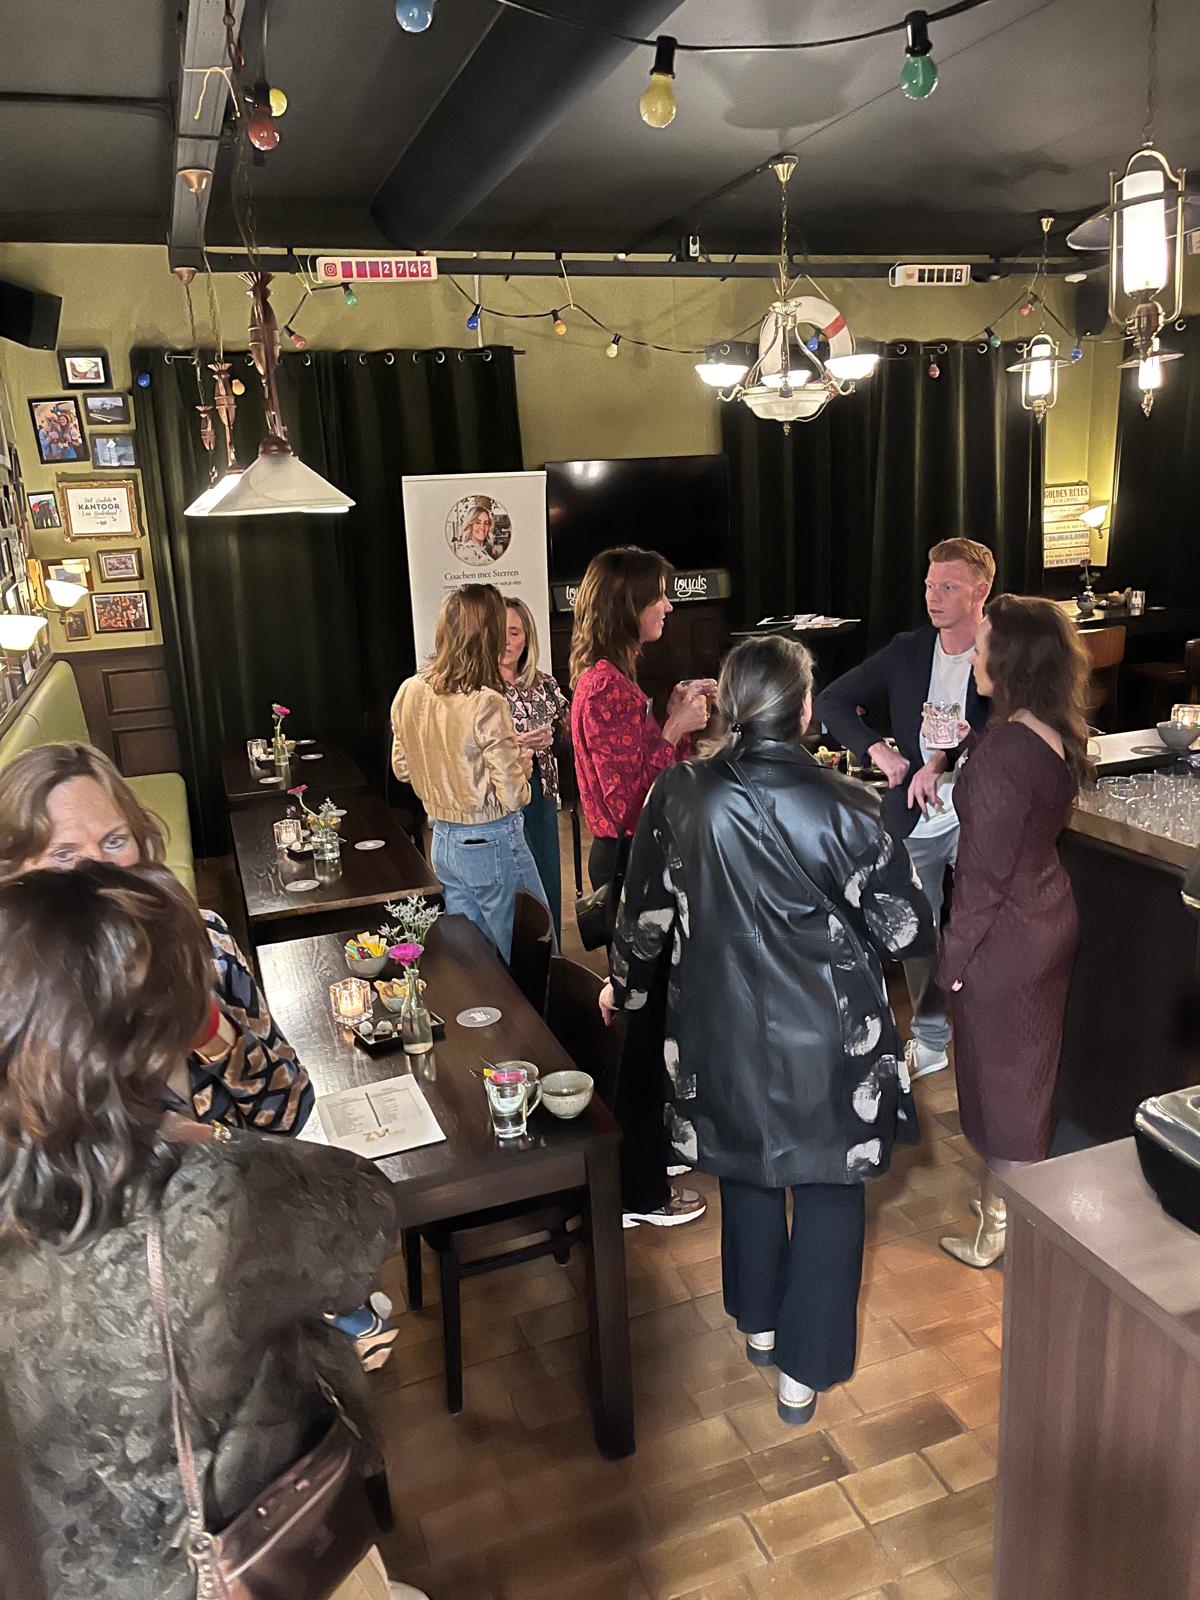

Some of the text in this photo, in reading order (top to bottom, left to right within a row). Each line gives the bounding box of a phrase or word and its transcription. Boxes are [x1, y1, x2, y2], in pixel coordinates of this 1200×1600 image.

[383, 263, 429, 274] 2742
[955, 270, 962, 280] 2
[444, 569, 519, 581] Coachen met Sterren
